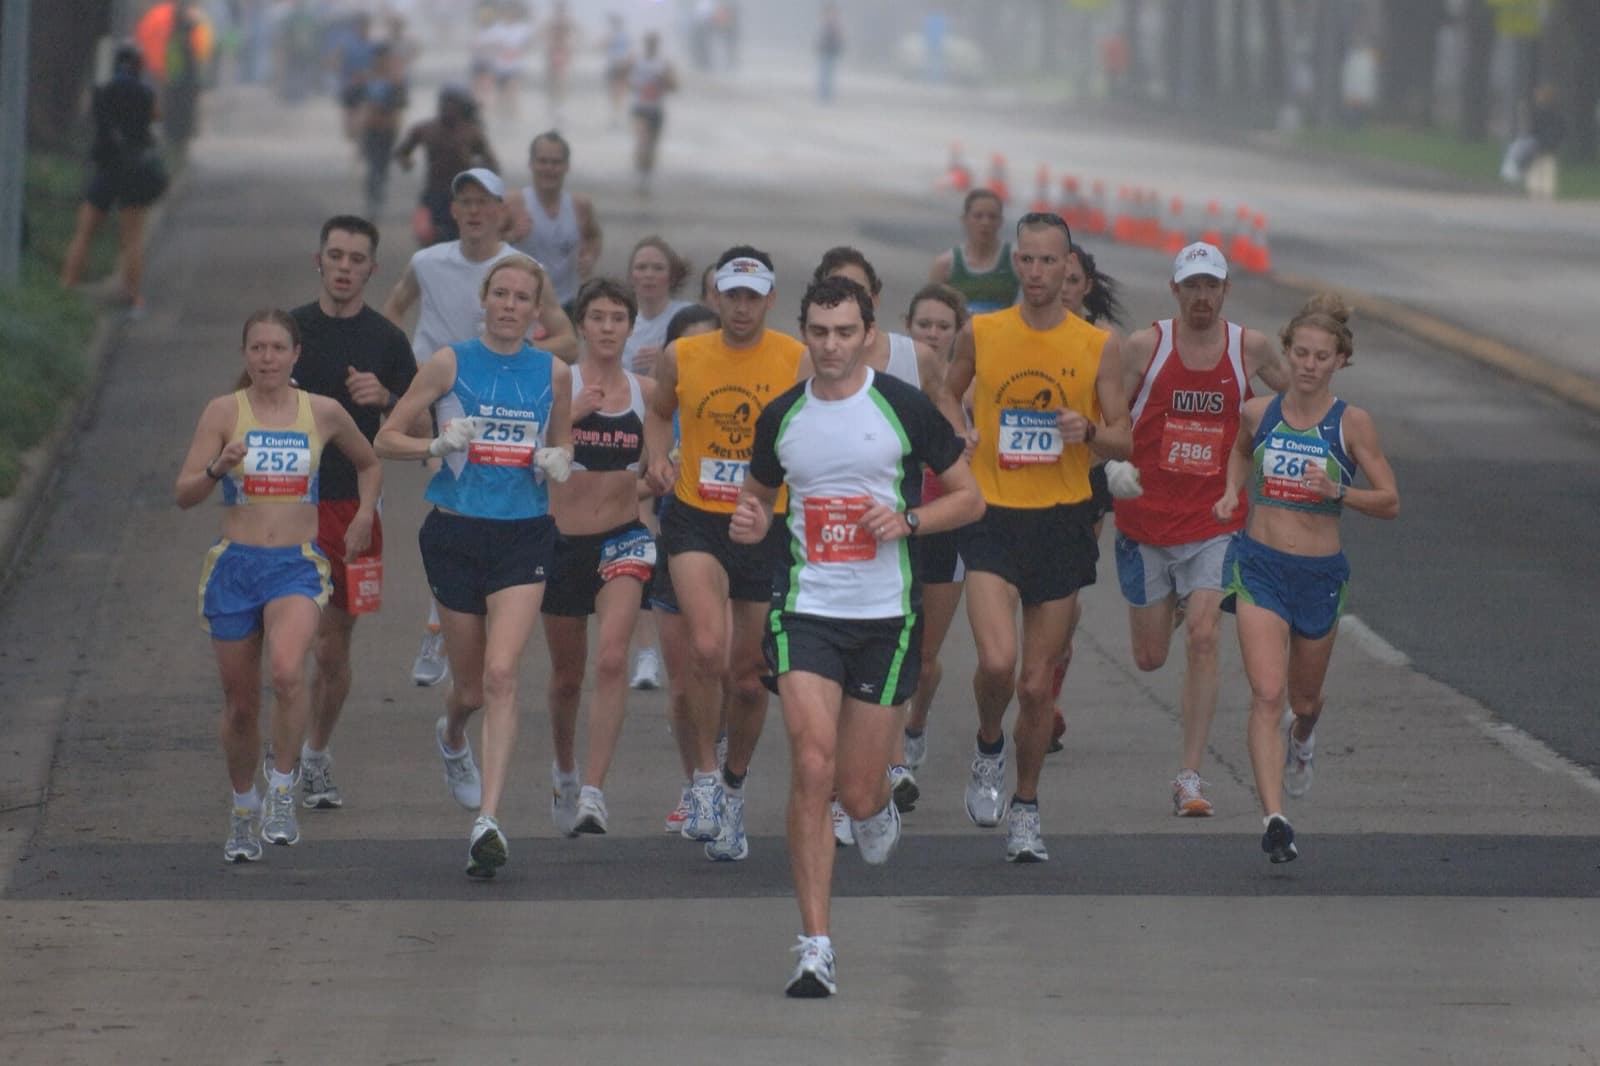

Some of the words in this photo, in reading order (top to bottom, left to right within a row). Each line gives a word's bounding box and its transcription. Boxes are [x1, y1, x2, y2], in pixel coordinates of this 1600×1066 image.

[1173, 390, 1224, 413] MVS
[495, 407, 534, 419] Chevron
[265, 436, 304, 447] Chevron
[483, 422, 526, 442] 255
[1010, 431, 1052, 450] 270
[1168, 441, 1212, 461] 2586
[1286, 440, 1323, 454] Chevron
[256, 451, 298, 472] 252
[821, 525, 857, 542] 607
